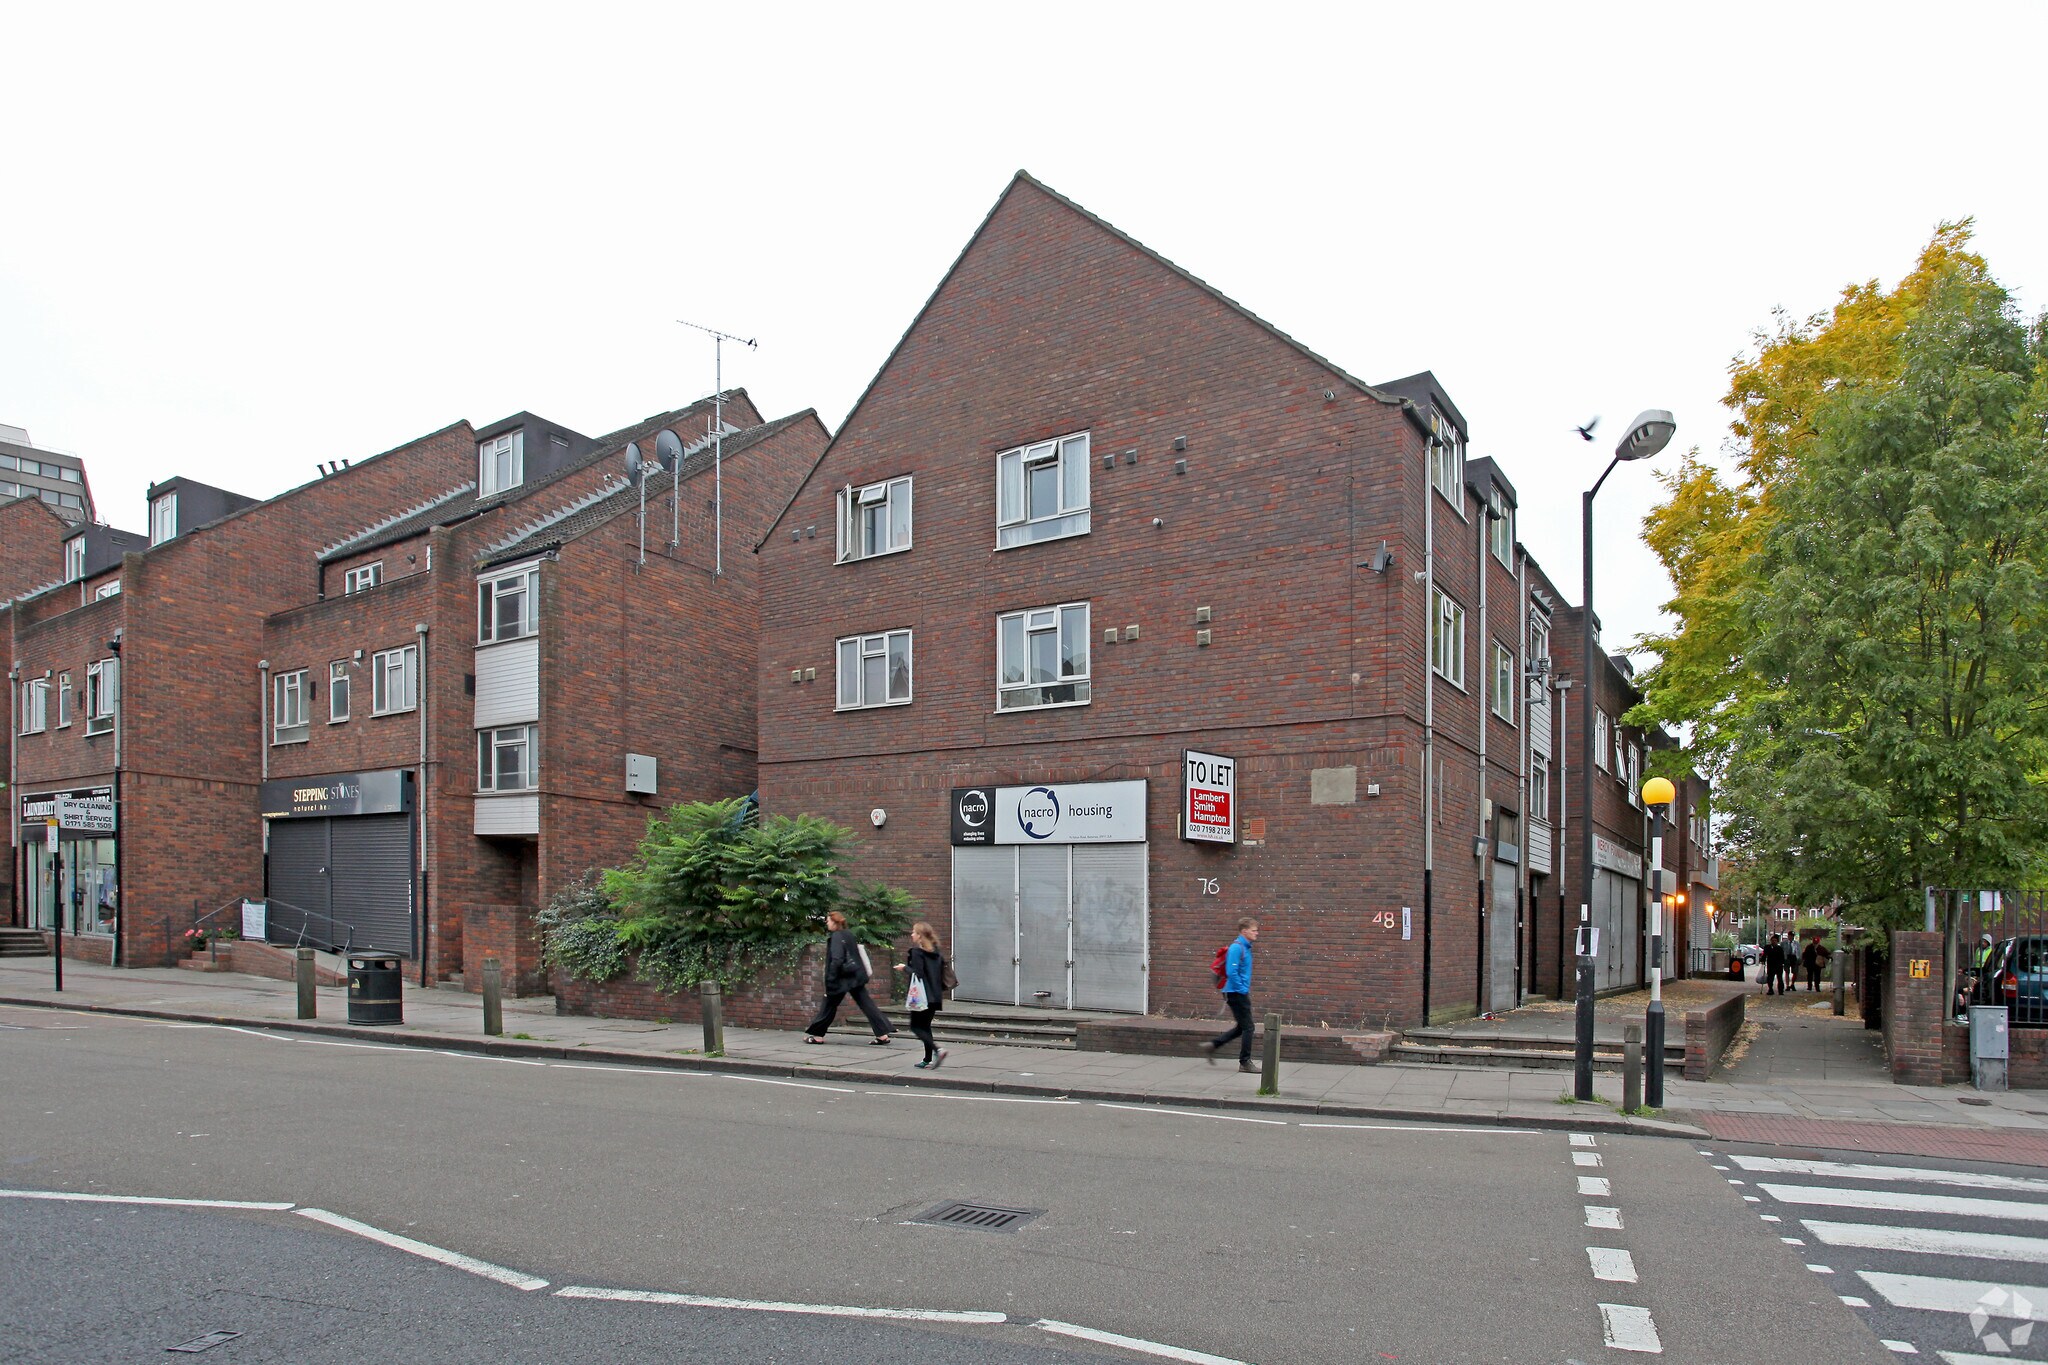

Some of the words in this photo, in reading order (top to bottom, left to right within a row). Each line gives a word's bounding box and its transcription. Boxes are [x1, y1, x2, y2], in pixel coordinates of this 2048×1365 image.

[1188, 760, 1207, 784] TO
[1210, 763, 1231, 787] LET
[293, 787, 329, 803] STEPPING
[1193, 790, 1225, 803] Lambert
[79, 802, 112, 810] CLEANING
[962, 804, 985, 813] nacro
[1024, 806, 1054, 818] nacro
[1068, 803, 1113, 819] housing
[1193, 801, 1216, 812] Smith
[85, 815, 112, 823] SERVICE
[1193, 810, 1227, 824] Hampton
[1189, 824, 1200, 832] 020
[1201, 825, 1216, 834] 7198
[1217, 827, 1231, 836] 2128
[1197, 877, 1220, 895] 76
[1372, 911, 1395, 929] 48
